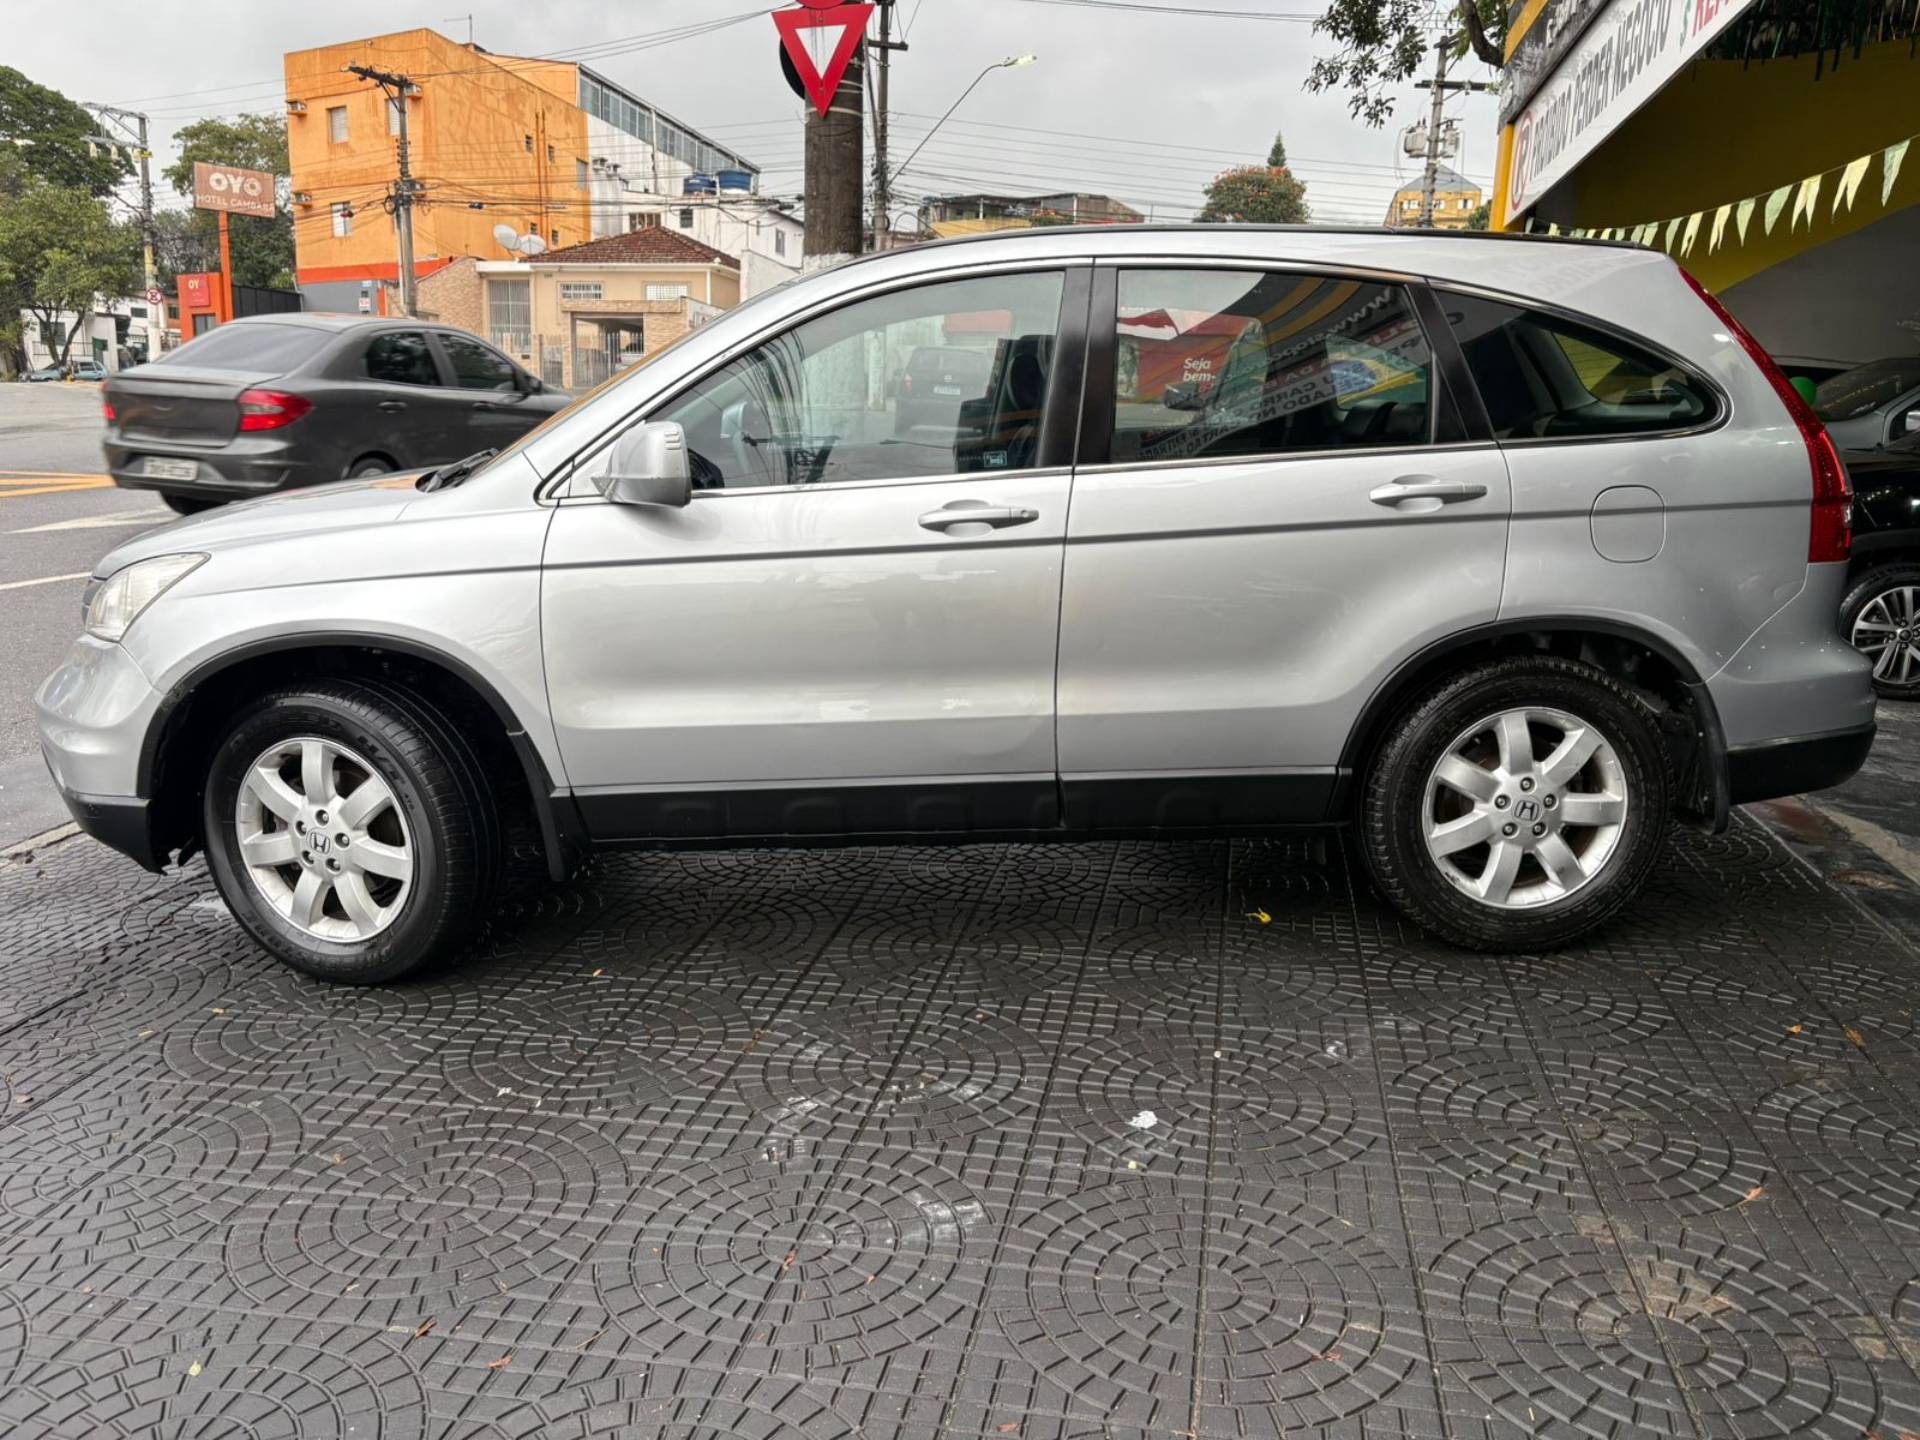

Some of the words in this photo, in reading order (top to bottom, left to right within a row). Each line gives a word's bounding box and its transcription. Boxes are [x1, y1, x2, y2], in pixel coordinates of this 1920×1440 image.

[1530, 83, 1573, 183] PROIBIDO
[1570, 35, 1614, 143] PERDER
[209, 172, 262, 197] OYO
[196, 194, 228, 206] HOTEL
[1184, 358, 1212, 371] Seja
[1183, 370, 1217, 381] bem-
